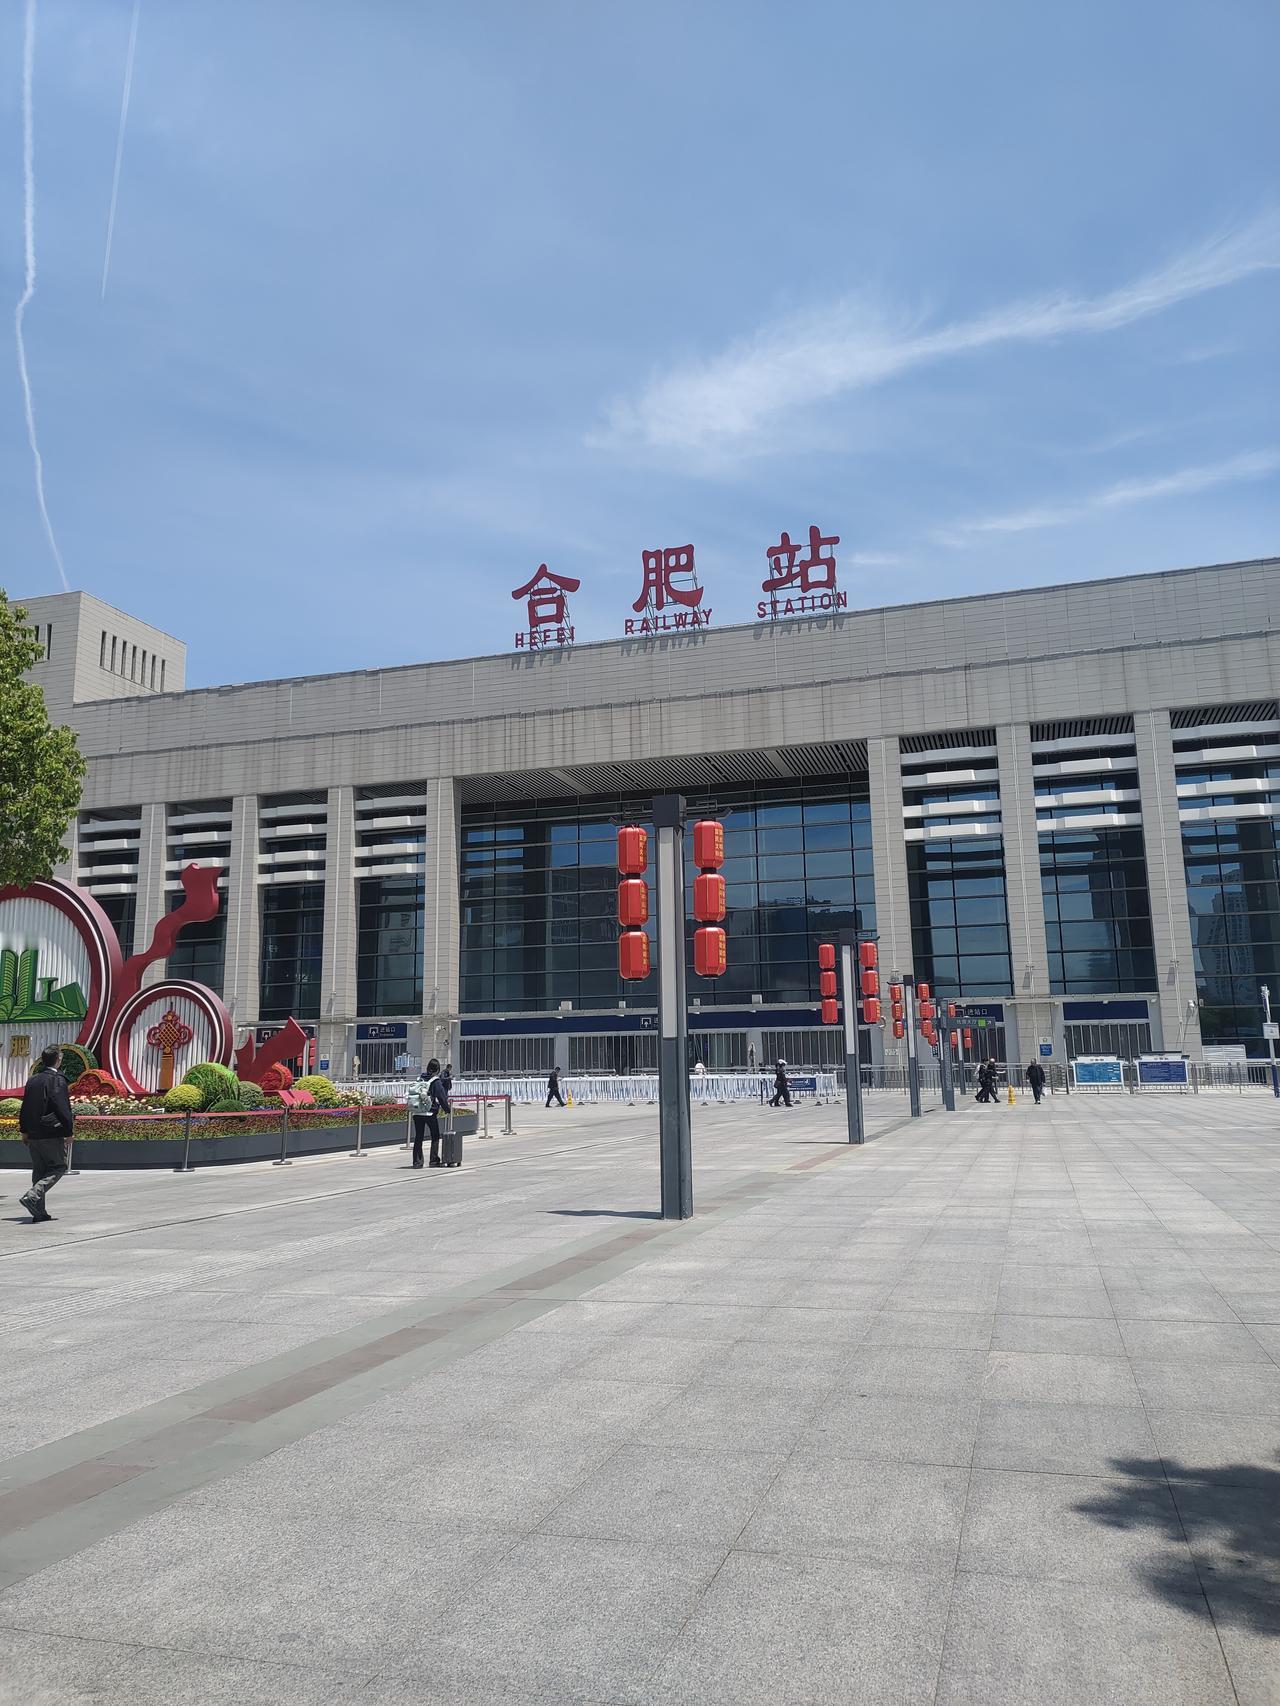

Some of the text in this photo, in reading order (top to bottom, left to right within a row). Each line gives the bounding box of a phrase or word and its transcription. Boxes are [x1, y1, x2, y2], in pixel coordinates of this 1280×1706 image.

[511, 525, 840, 628] 合肥站
[514, 591, 848, 649] HEFEI RAILWAY STATION
